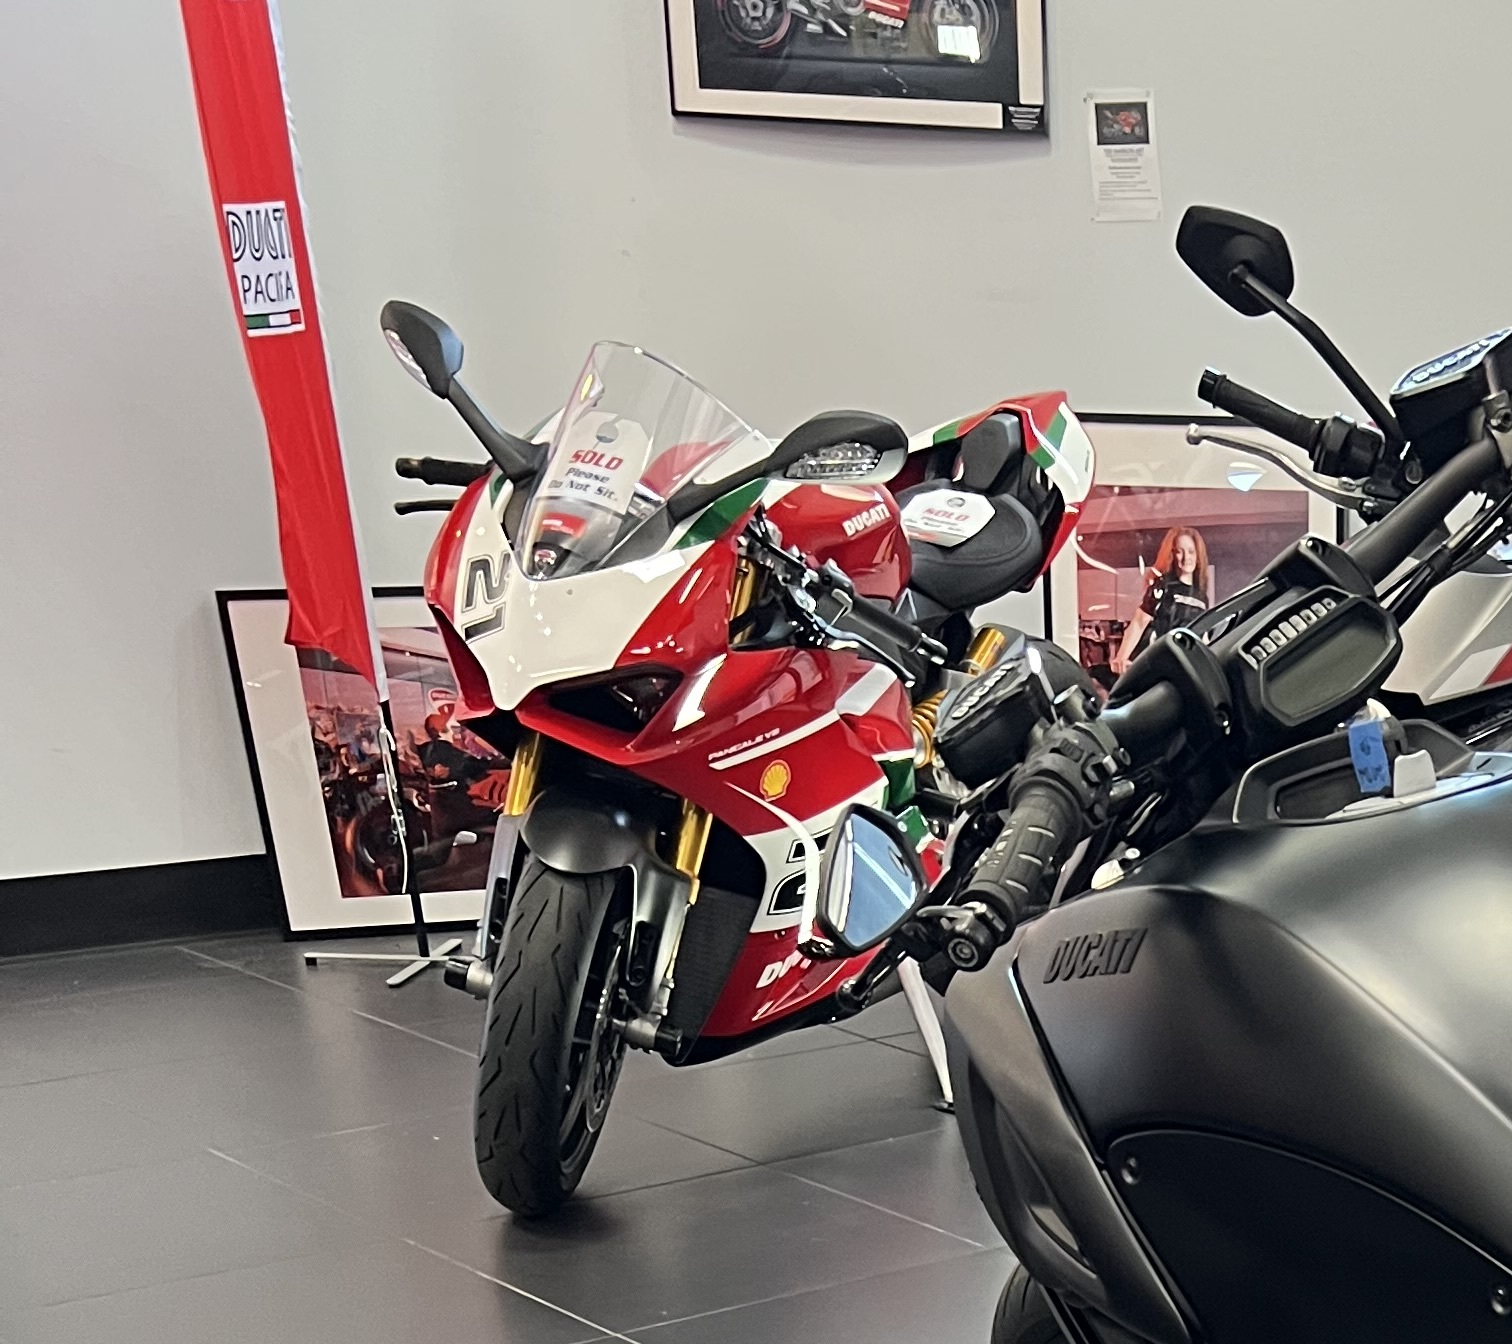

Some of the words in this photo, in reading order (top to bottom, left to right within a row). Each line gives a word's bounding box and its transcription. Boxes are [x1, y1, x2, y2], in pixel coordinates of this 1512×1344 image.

[1411, 339, 1490, 383] DUCATI
[564, 467, 611, 484] Please
[568, 449, 624, 471] SOLD
[566, 480, 591, 492] Not
[593, 486, 619, 502] Sit.
[842, 503, 891, 537] DUCATI
[951, 663, 1017, 719] DUCATI
[1043, 927, 1149, 984] DUCATI
